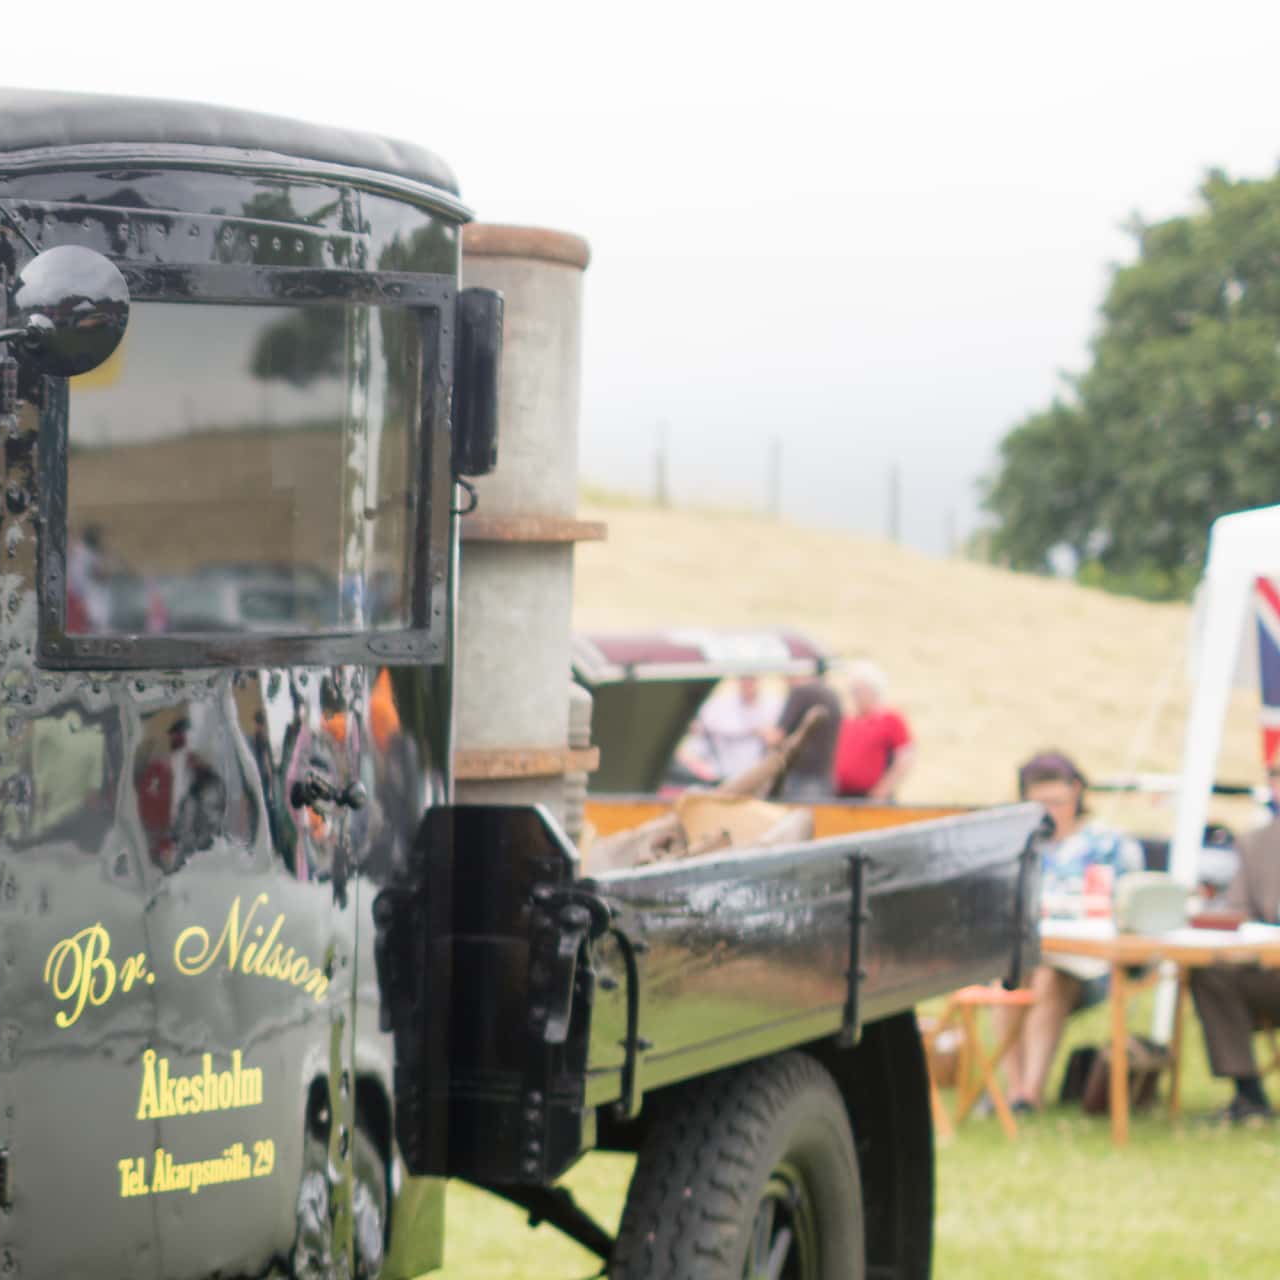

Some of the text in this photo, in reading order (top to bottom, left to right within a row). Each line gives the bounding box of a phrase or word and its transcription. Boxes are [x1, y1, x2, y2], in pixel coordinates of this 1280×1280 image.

[45, 893, 330, 1028] Br. Nilsson
[137, 1049, 262, 1120] Åkesholm
[118, 1140, 276, 1198] Tel. Åkarpsmölla 29
